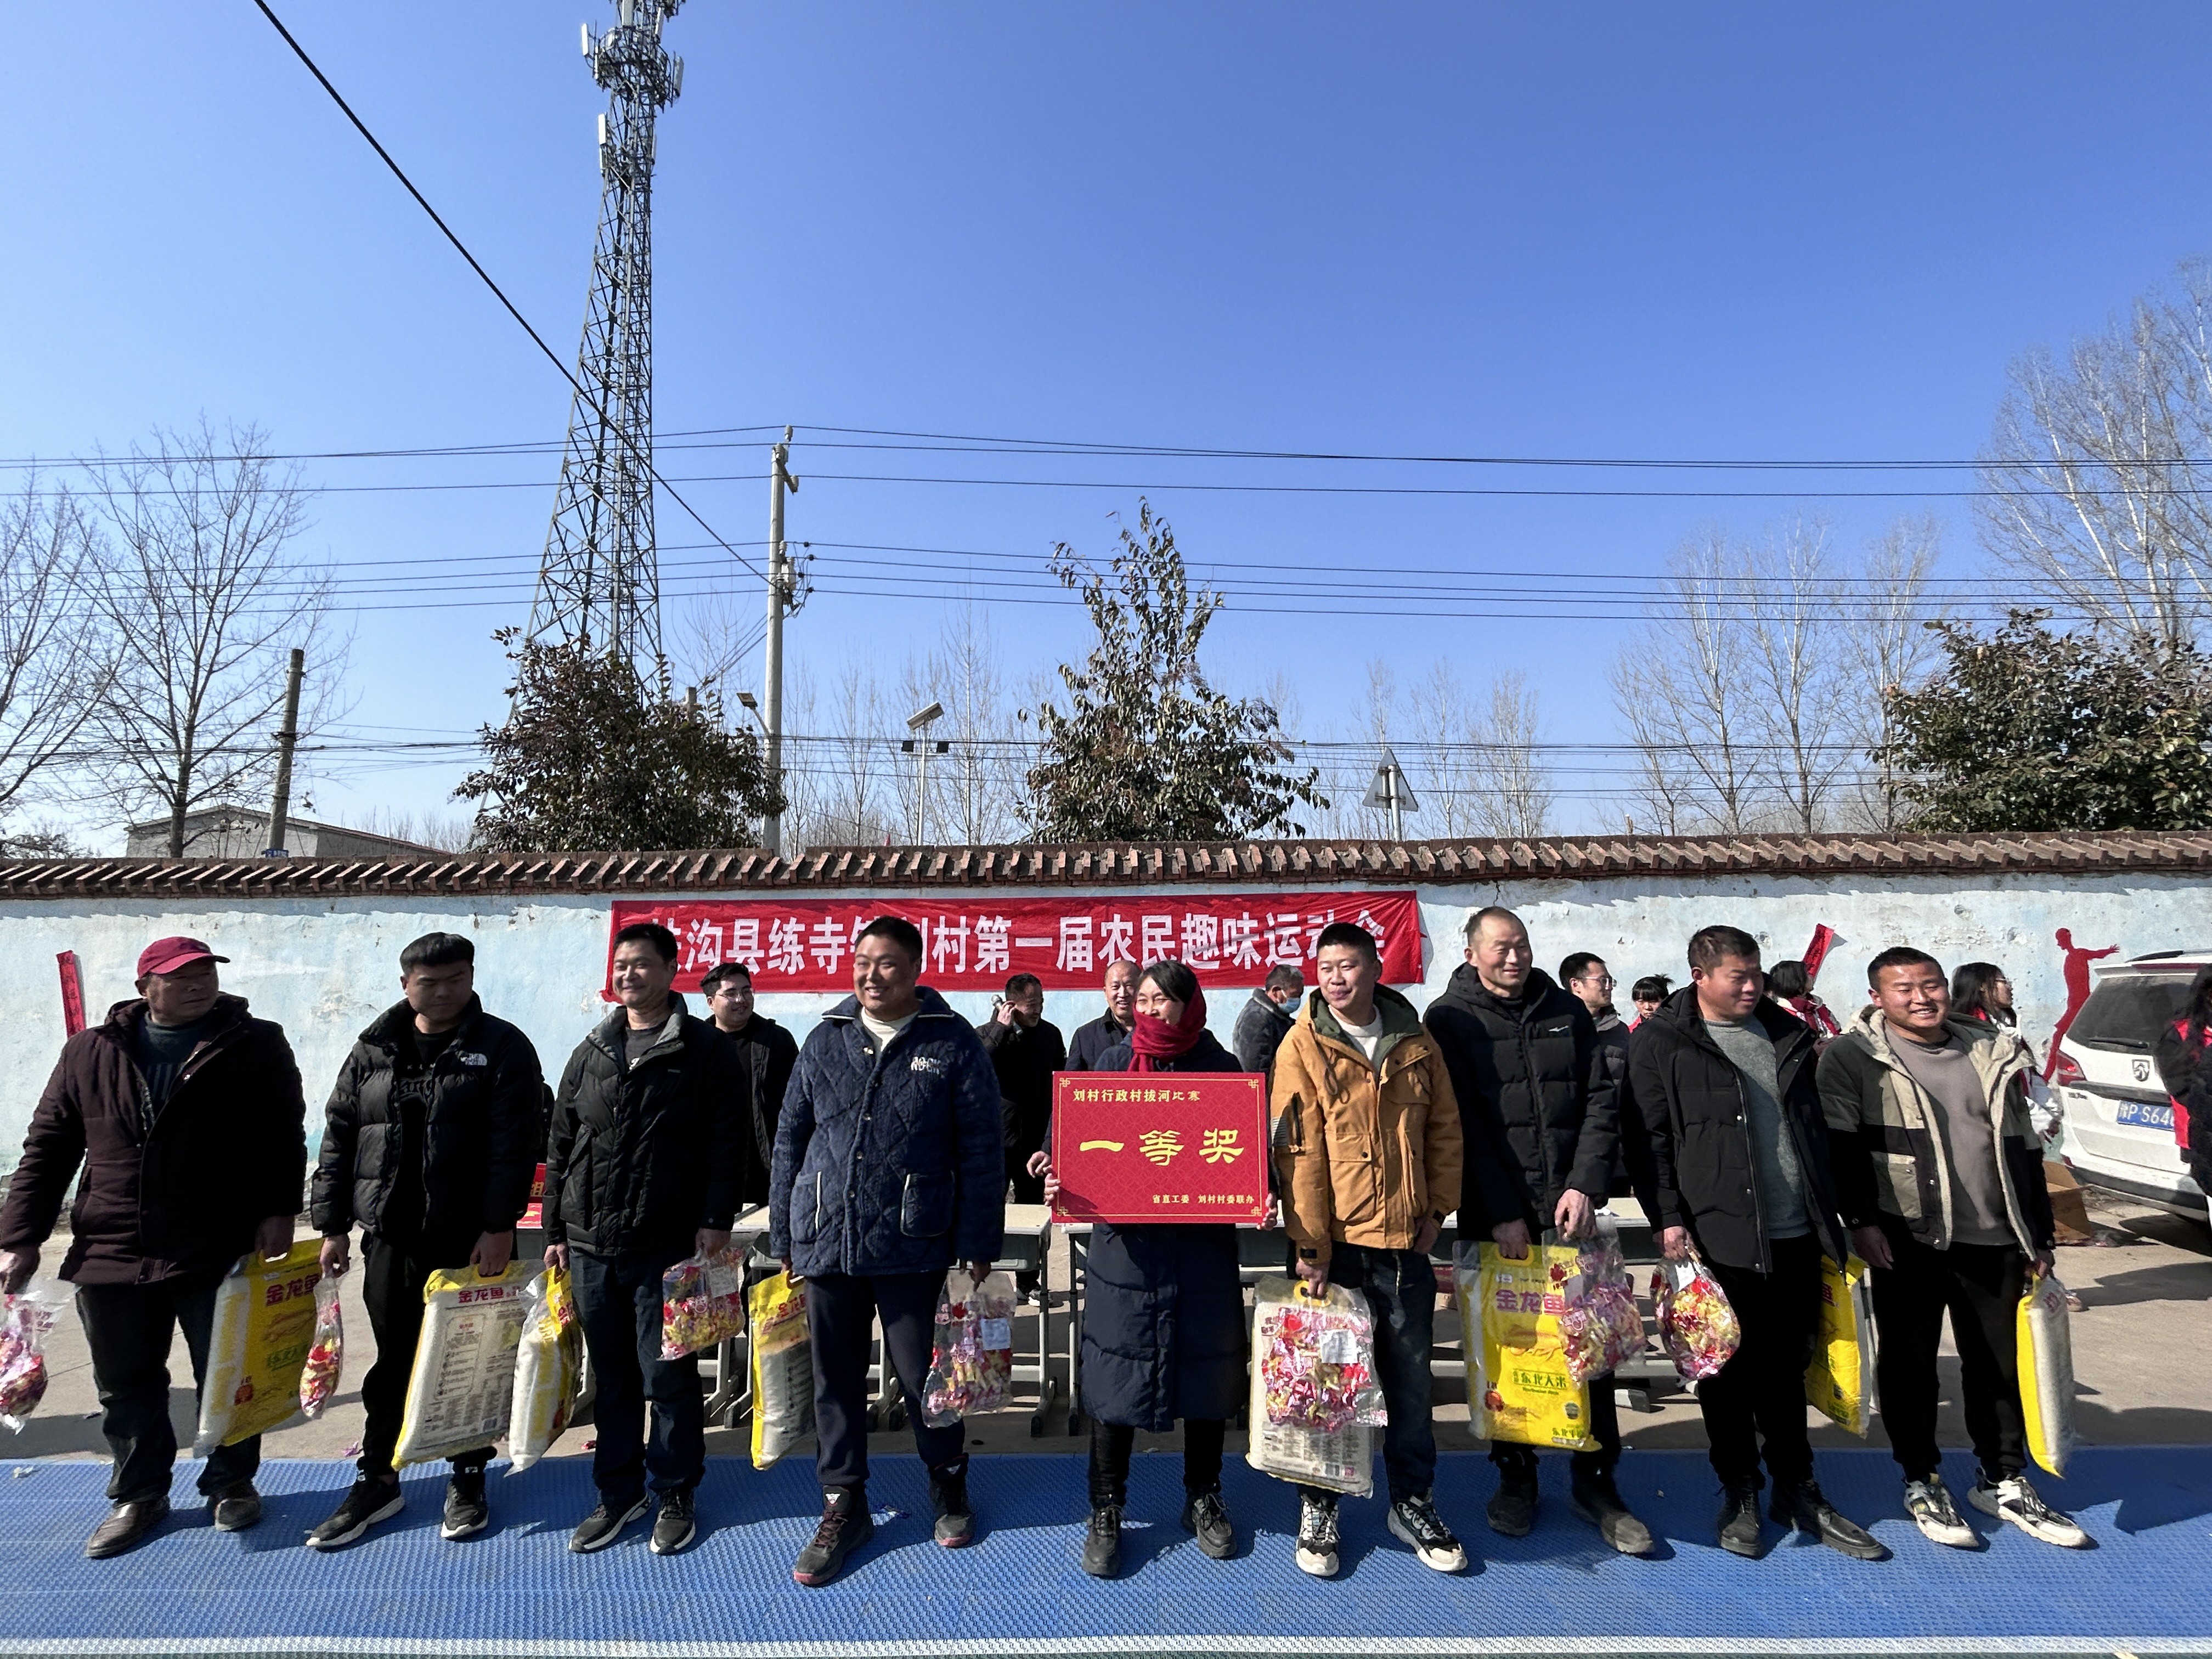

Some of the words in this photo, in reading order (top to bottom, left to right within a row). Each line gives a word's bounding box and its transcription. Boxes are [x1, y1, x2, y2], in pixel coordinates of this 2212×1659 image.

[1079, 1127, 1245, 1166] 一等奖
[1197, 1194, 1255, 1205] 刘村村委联办
[458, 1286, 504, 1304] 金龙鱼
[1496, 1289, 1566, 1315] 金龙鱼
